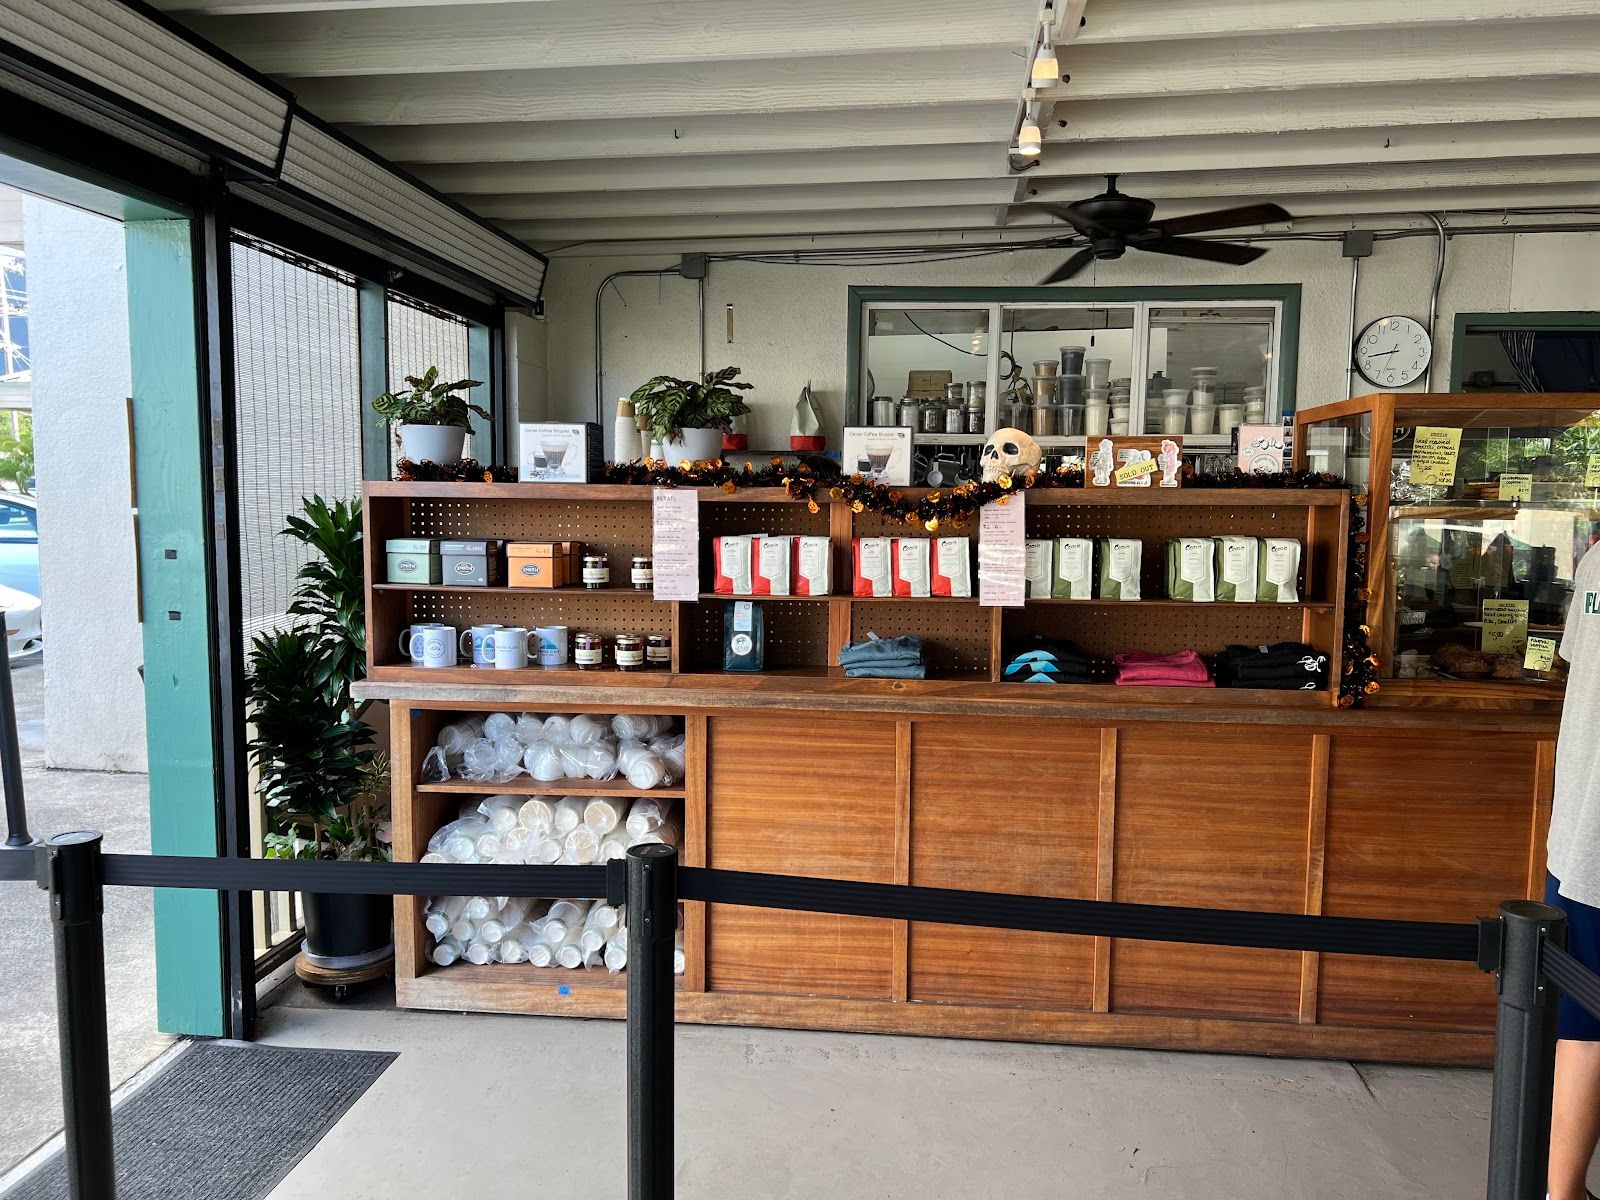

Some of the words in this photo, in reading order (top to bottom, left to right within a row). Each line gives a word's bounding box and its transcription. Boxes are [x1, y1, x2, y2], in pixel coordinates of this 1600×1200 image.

[1378, 325, 1386, 334] 11
[1390, 321, 1399, 331] 12
[1366, 334, 1378, 344] 10
[1414, 334, 1422, 344] 2
[1361, 346, 1368, 356] 9
[1419, 348, 1425, 357] 3
[1364, 360, 1371, 370] 8
[1412, 360, 1418, 370] 4
[1374, 370, 1381, 380] 7
[1387, 374, 1394, 383] 6
[1402, 370, 1408, 380] 5
[1119, 470, 1137, 480] SOLD
[1140, 464, 1154, 473] OUT
[1585, 592, 1600, 614] PL
